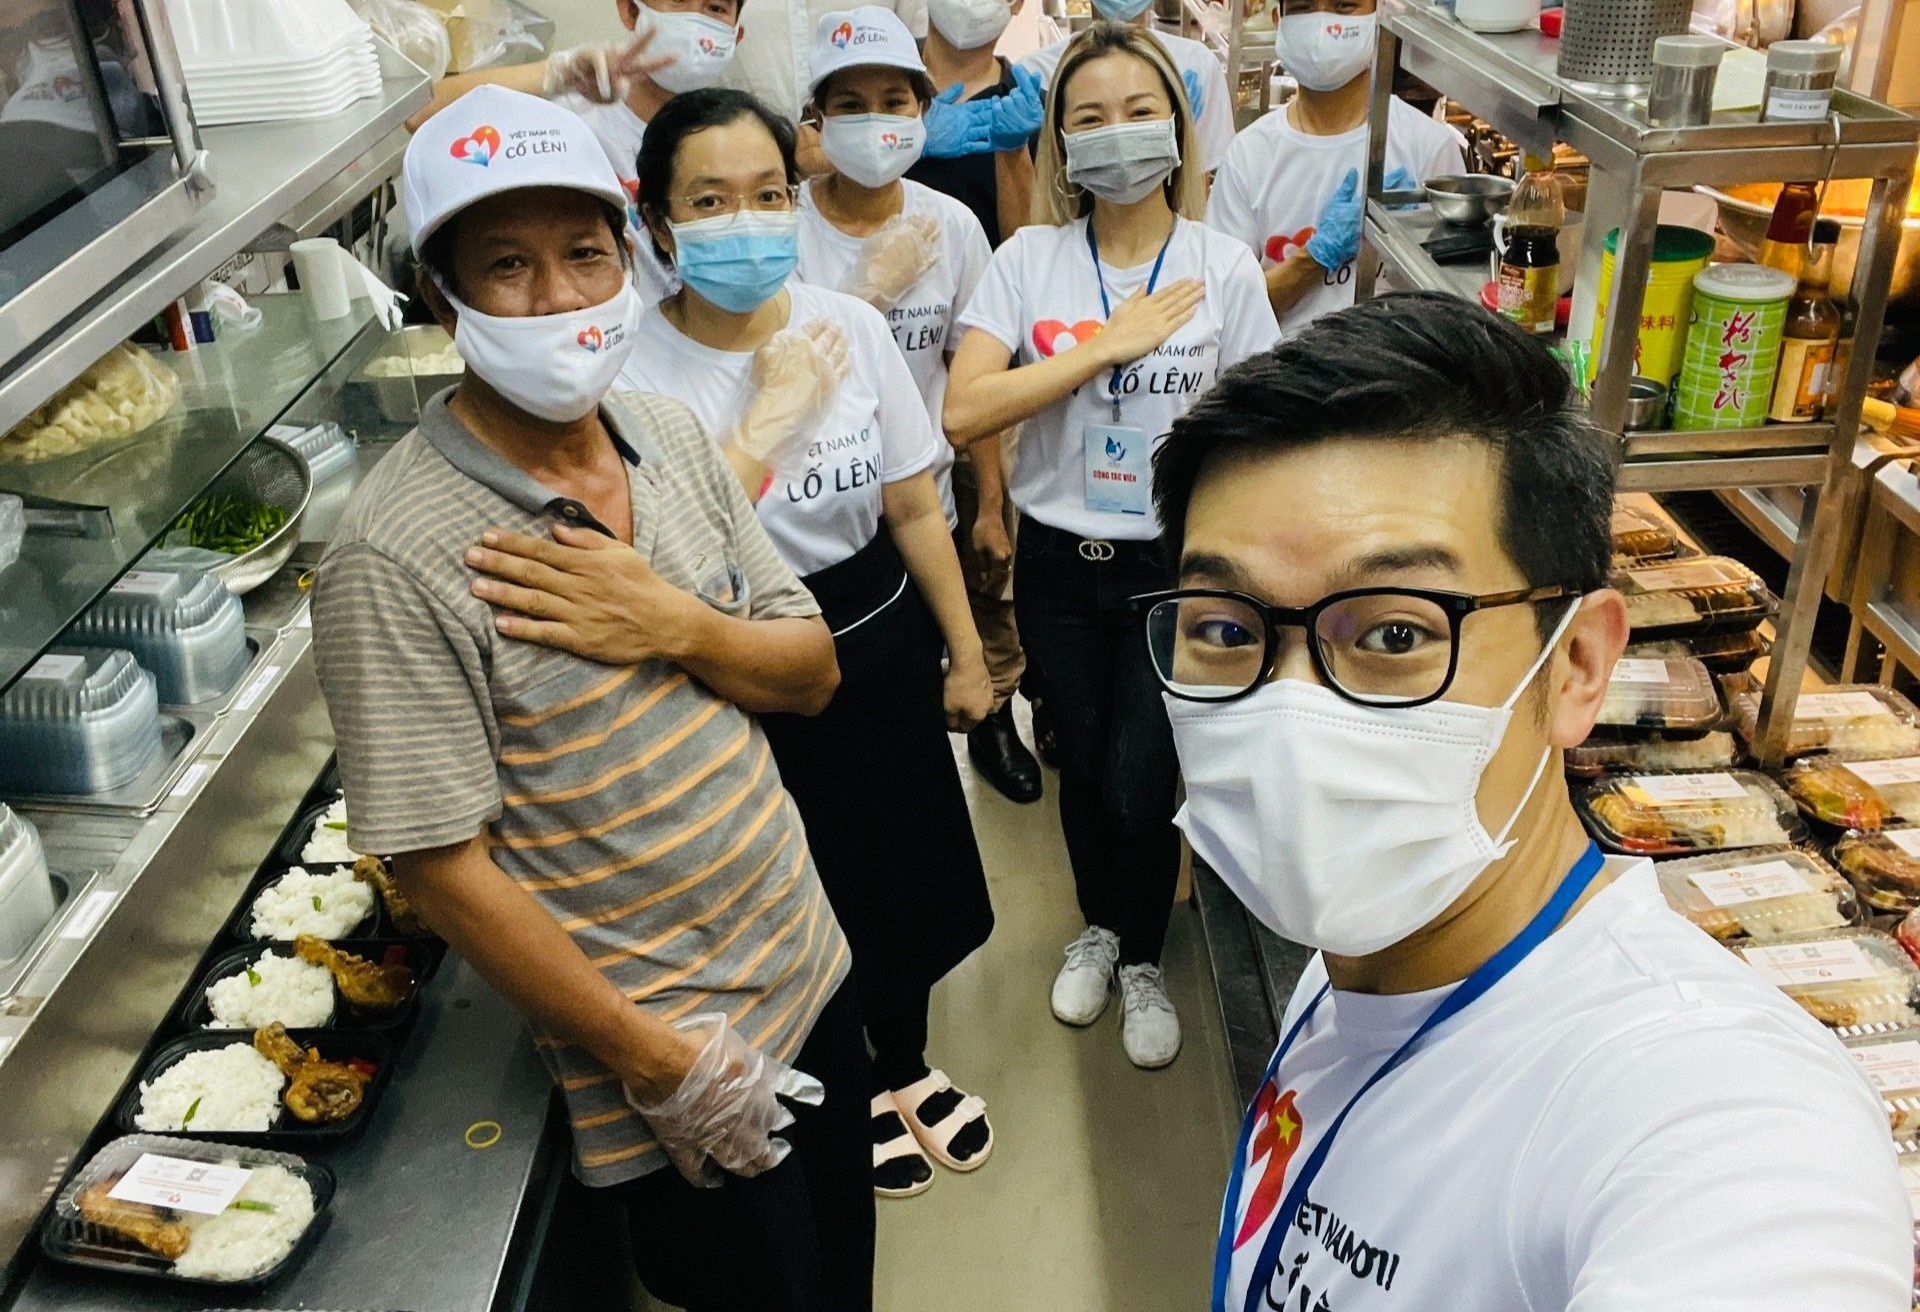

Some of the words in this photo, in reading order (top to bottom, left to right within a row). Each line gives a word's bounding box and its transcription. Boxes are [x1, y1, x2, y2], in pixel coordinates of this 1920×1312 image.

[528, 129, 547, 137] NAM
[505, 140, 527, 159] CỐ
[532, 139, 567, 154] LÊN!
[907, 305, 932, 319] NAM
[906, 324, 944, 351] LÊN!
[1149, 366, 1203, 395] LÊN!
[826, 433, 858, 452] NAM
[835, 452, 881, 493] LÊN!
